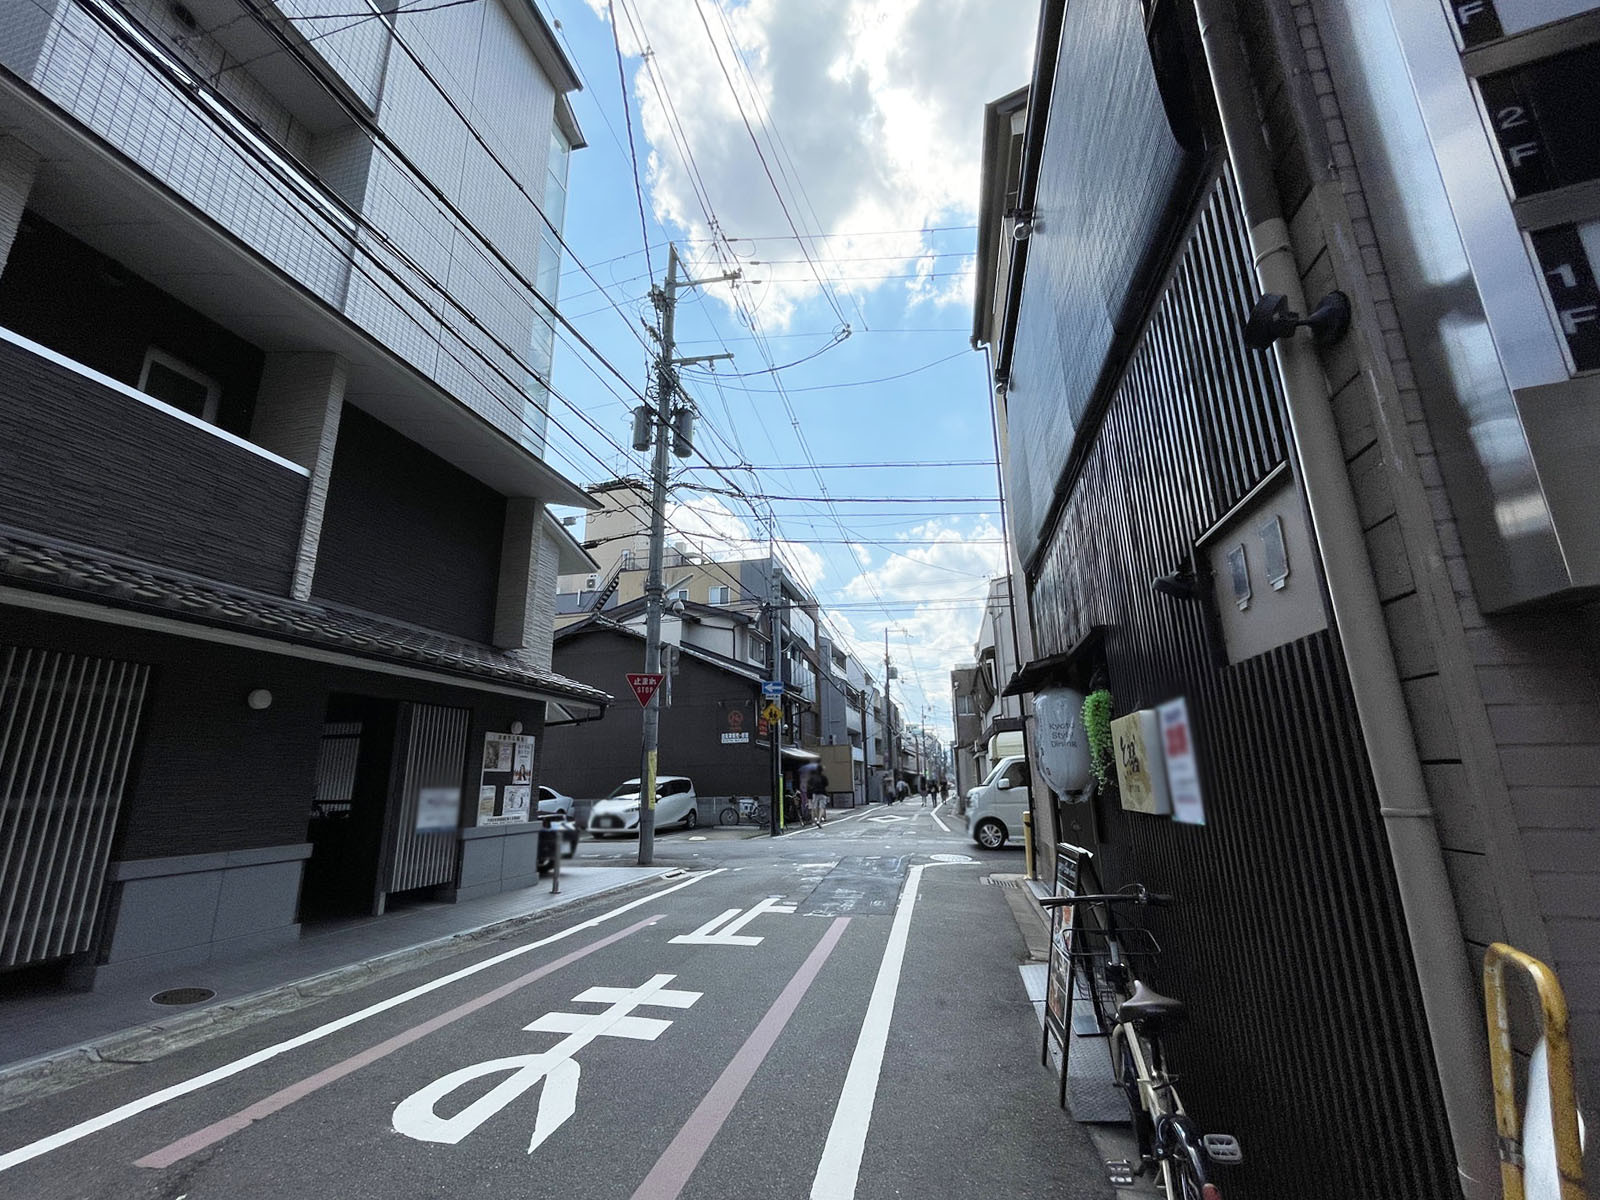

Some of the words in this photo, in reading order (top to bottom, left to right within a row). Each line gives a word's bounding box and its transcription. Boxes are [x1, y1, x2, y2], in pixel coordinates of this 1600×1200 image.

[633, 677, 657, 686] 止まれ
[637, 686, 654, 694] STOP
